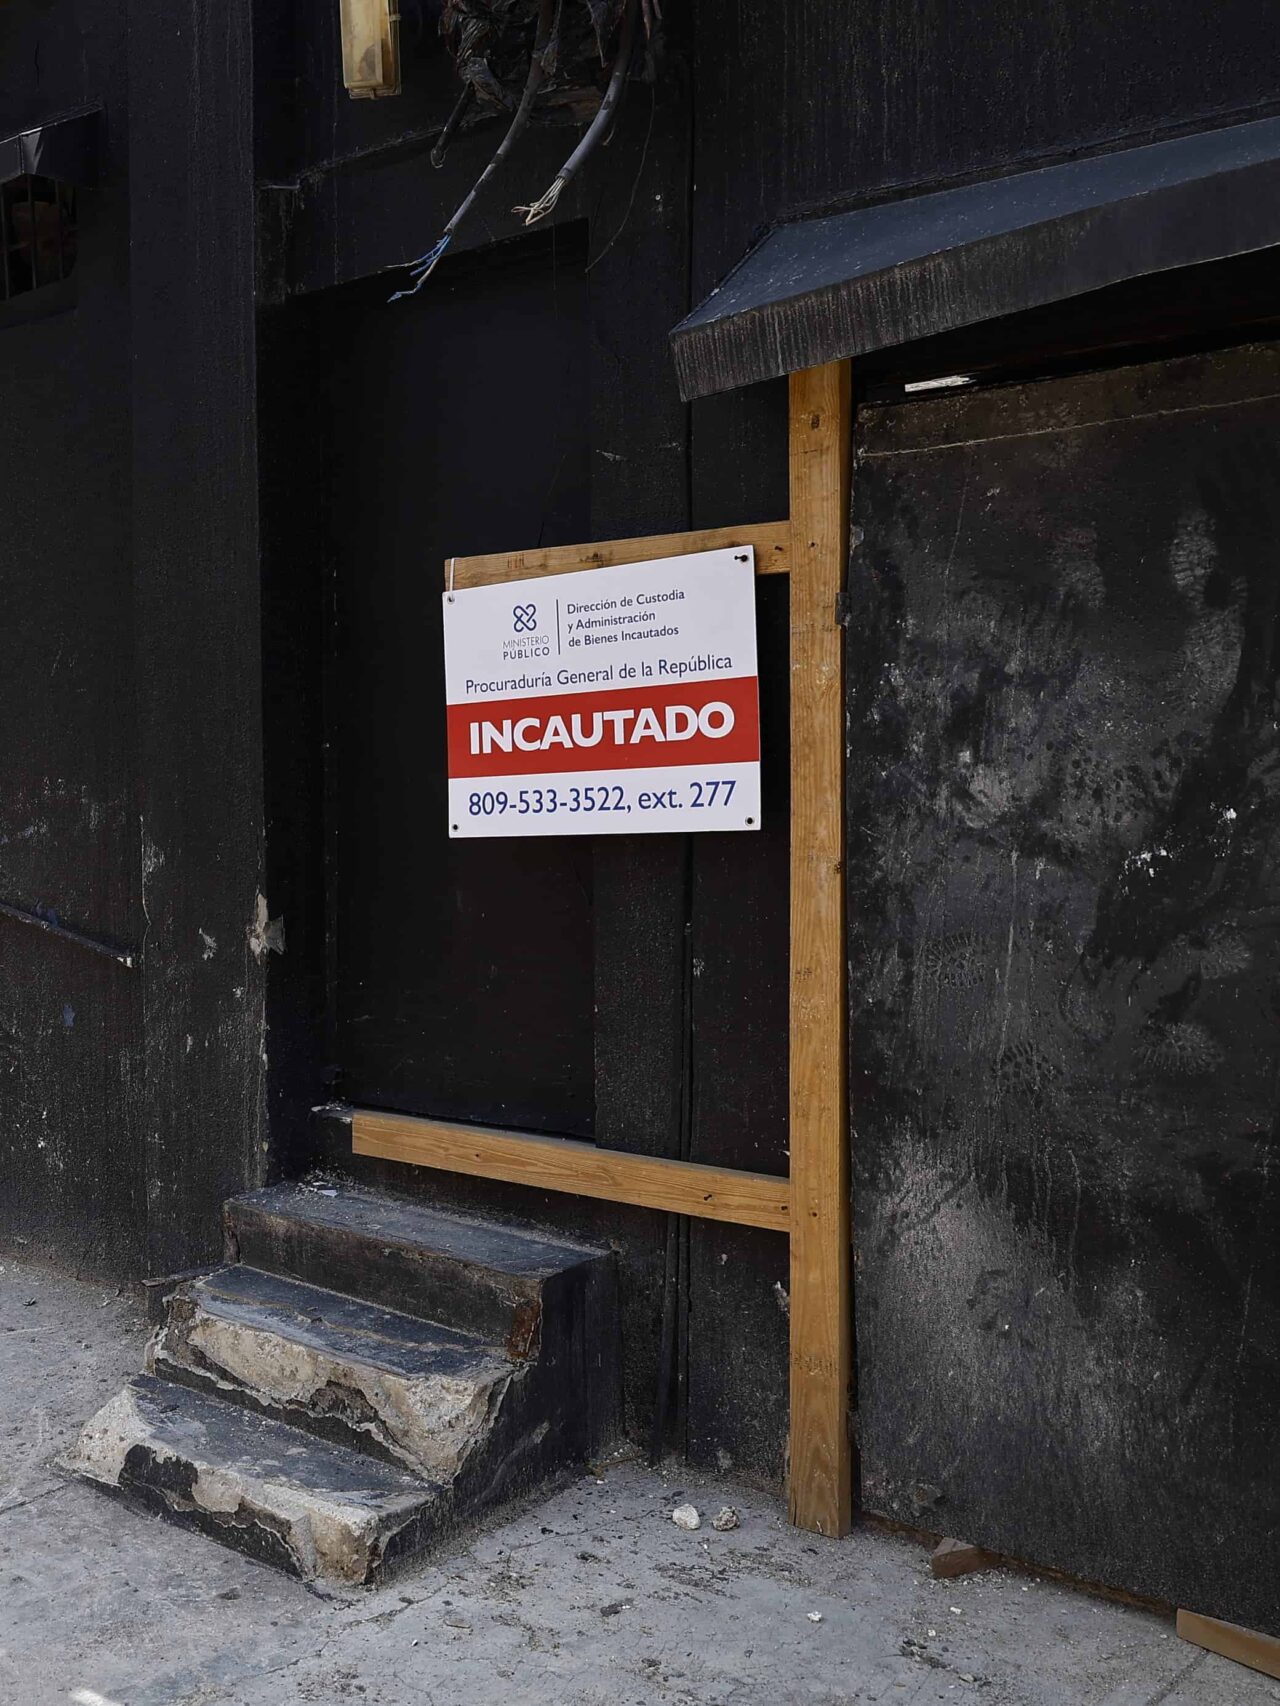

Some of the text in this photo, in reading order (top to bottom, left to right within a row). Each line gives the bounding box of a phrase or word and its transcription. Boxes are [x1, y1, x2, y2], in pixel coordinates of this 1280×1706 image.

[567, 589, 685, 614] Dirección de Custodia
[567, 611, 656, 634] y Administración
[502, 635, 550, 649] MINISTERIO
[568, 625, 679, 647] de Bienes Incautados
[503, 646, 550, 660] PÚBLICO
[466, 654, 732, 694] Procuraduría General de la República
[469, 701, 735, 755] INCAUTADO
[469, 780, 736, 816] 809-533-3522, ext. 277
